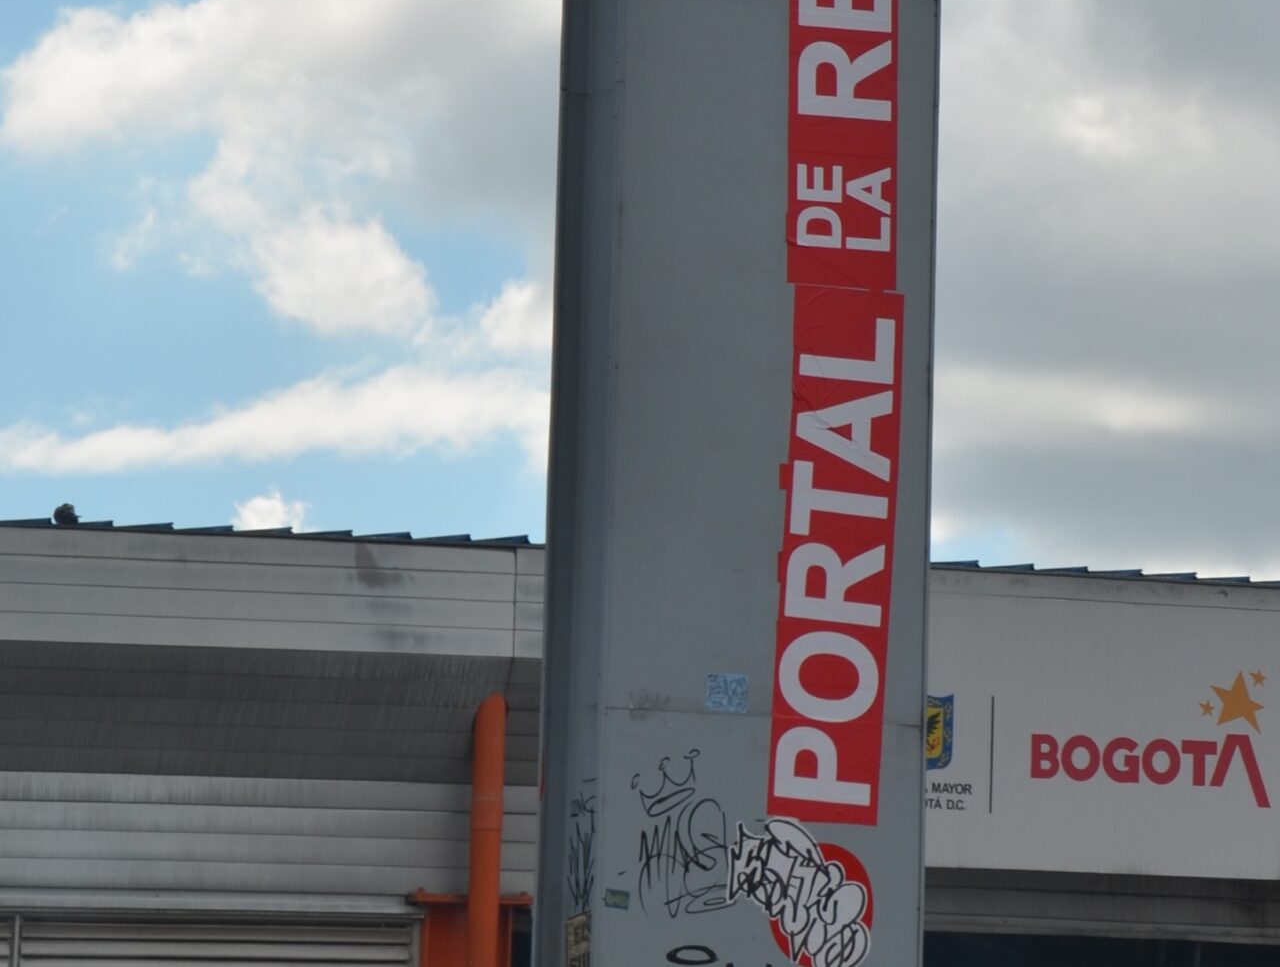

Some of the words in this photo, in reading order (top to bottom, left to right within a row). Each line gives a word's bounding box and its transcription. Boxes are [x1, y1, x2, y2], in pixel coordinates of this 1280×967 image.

[796, 163, 843, 250] DE
[845, 166, 892, 253] LA
[773, 317, 897, 807] PORTAL
[931, 781, 973, 795] MAYOR
